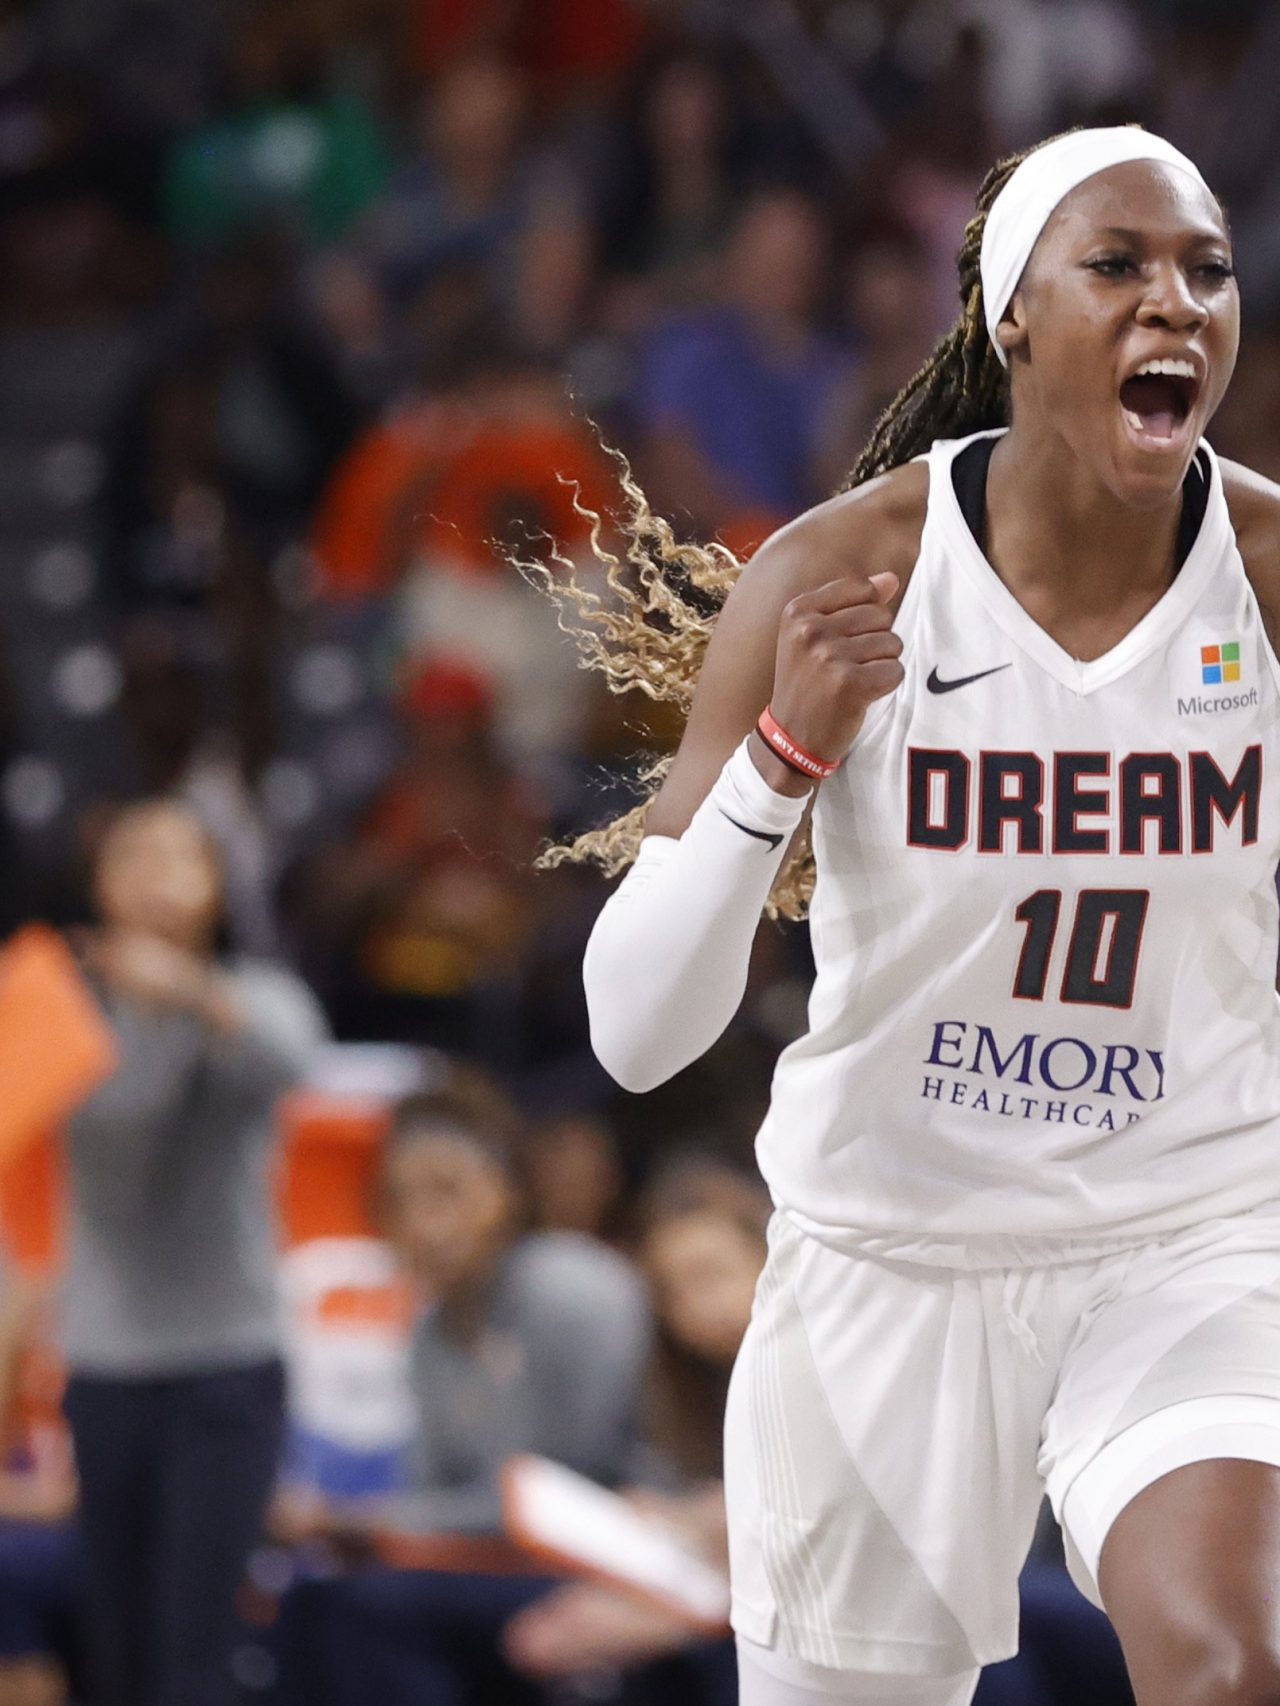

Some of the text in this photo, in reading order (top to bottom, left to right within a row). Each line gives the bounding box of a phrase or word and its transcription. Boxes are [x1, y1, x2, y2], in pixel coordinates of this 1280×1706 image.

[1177, 687, 1258, 715] Microsoft
[907, 744, 1262, 854] DREAM
[1012, 889, 1150, 1010] 10
[922, 1020, 1164, 1102] EMORY
[921, 1076, 1140, 1130] HEALTHCAR
